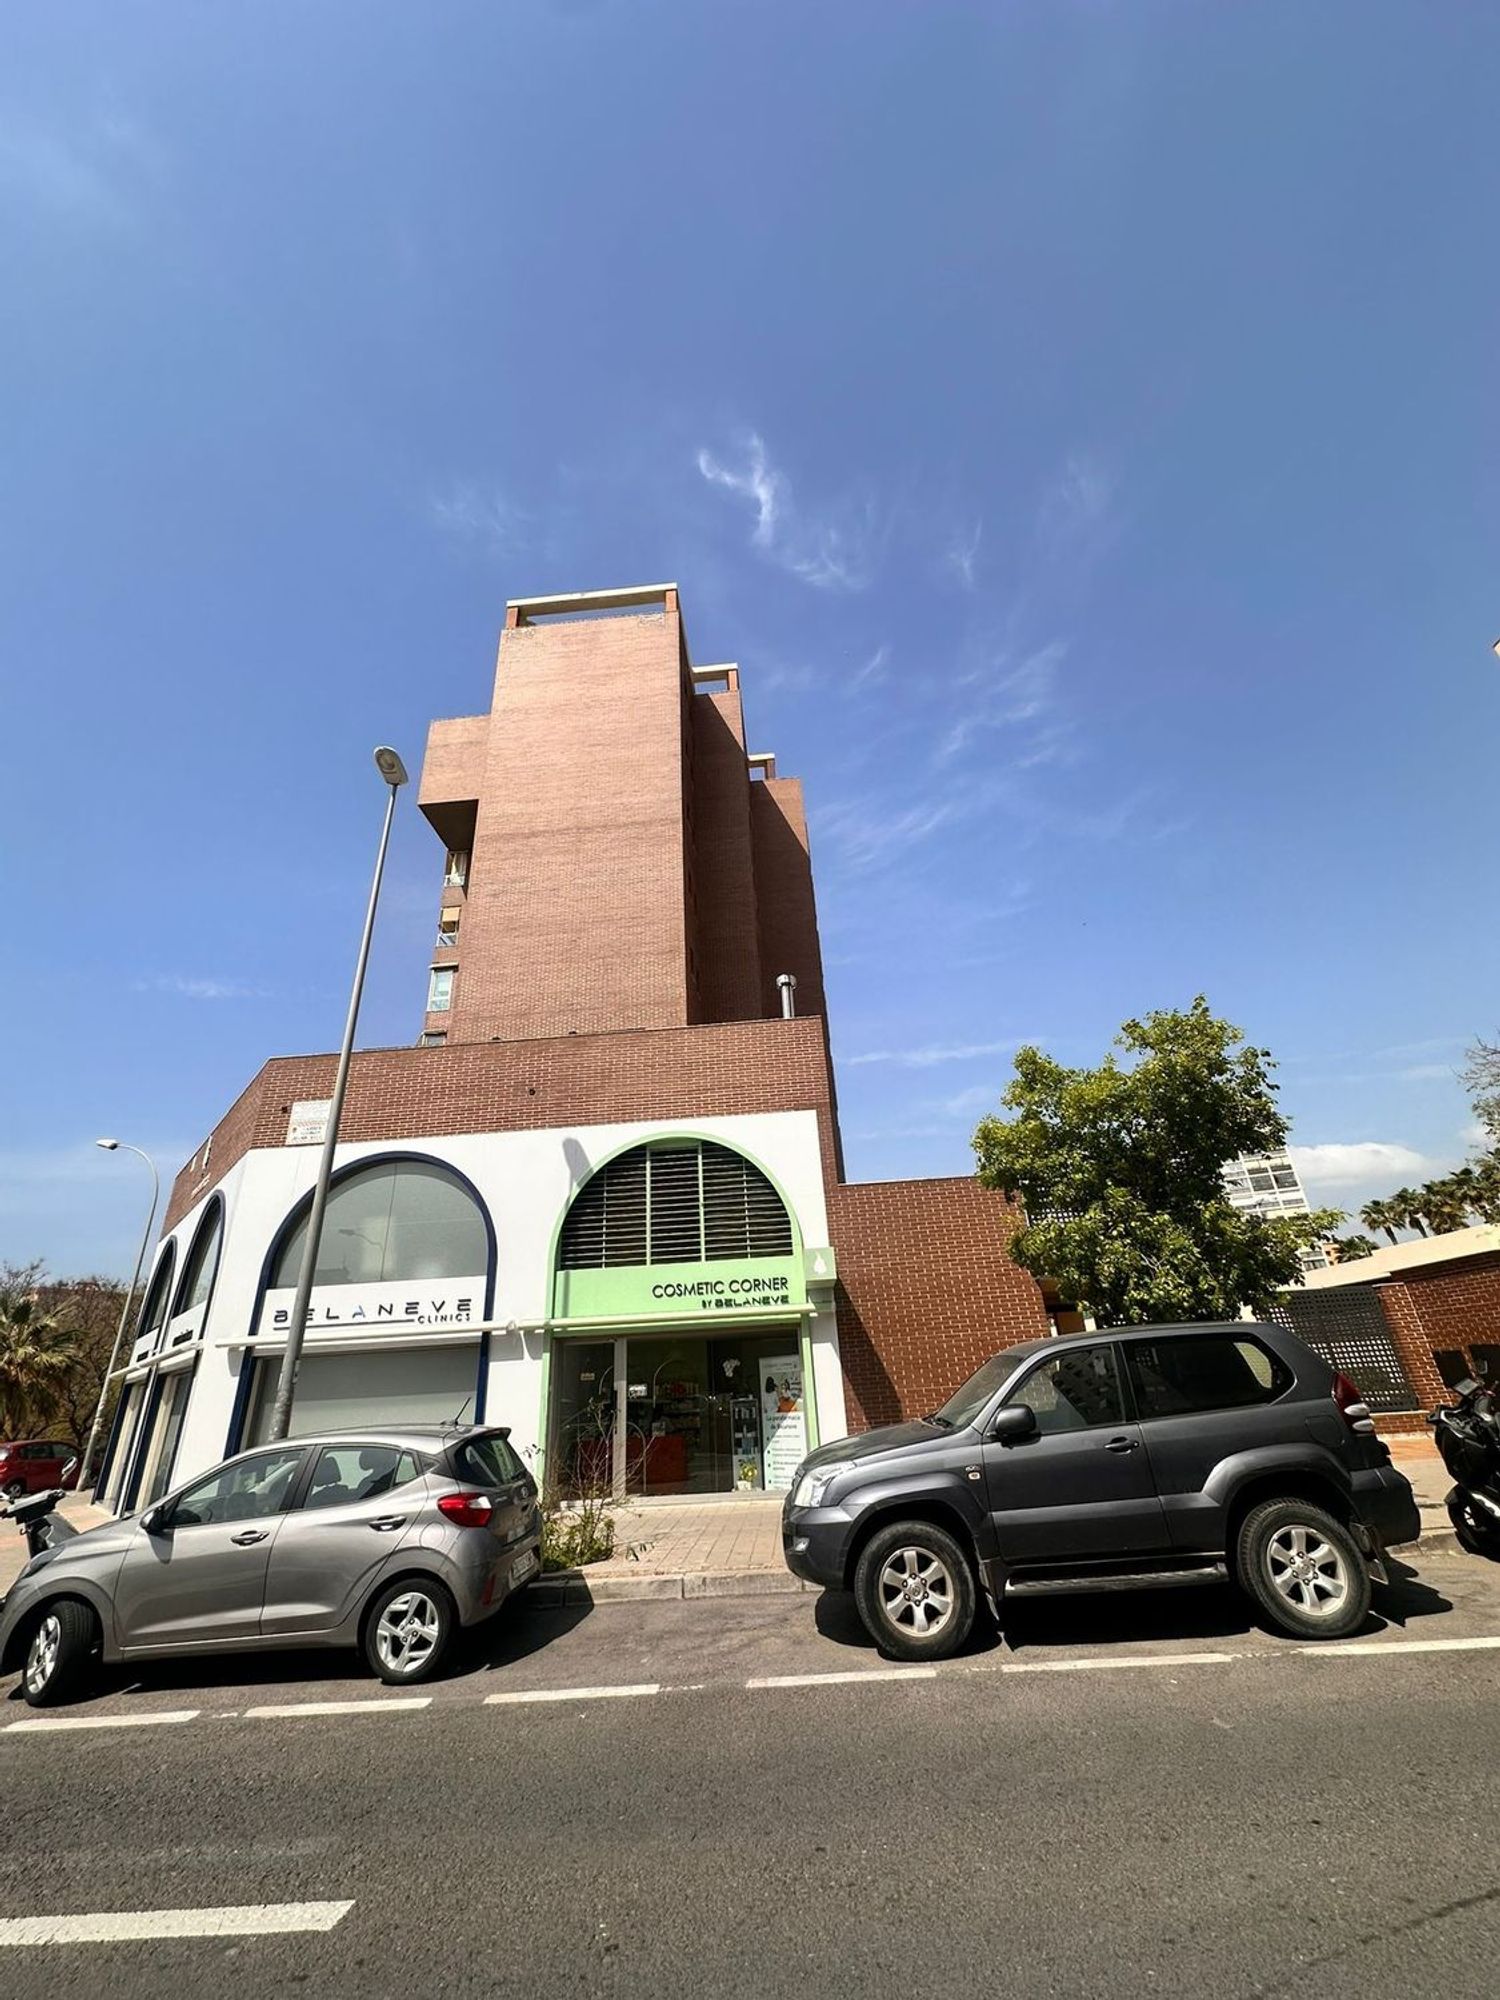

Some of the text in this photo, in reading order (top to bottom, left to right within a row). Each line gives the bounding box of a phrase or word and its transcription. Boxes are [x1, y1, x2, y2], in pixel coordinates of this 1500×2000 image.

[651, 1277, 789, 1298] COSMETIC CORNER
[702, 1294, 790, 1309] BY BELANEVE
[417, 1312, 471, 1325] CLINICS
